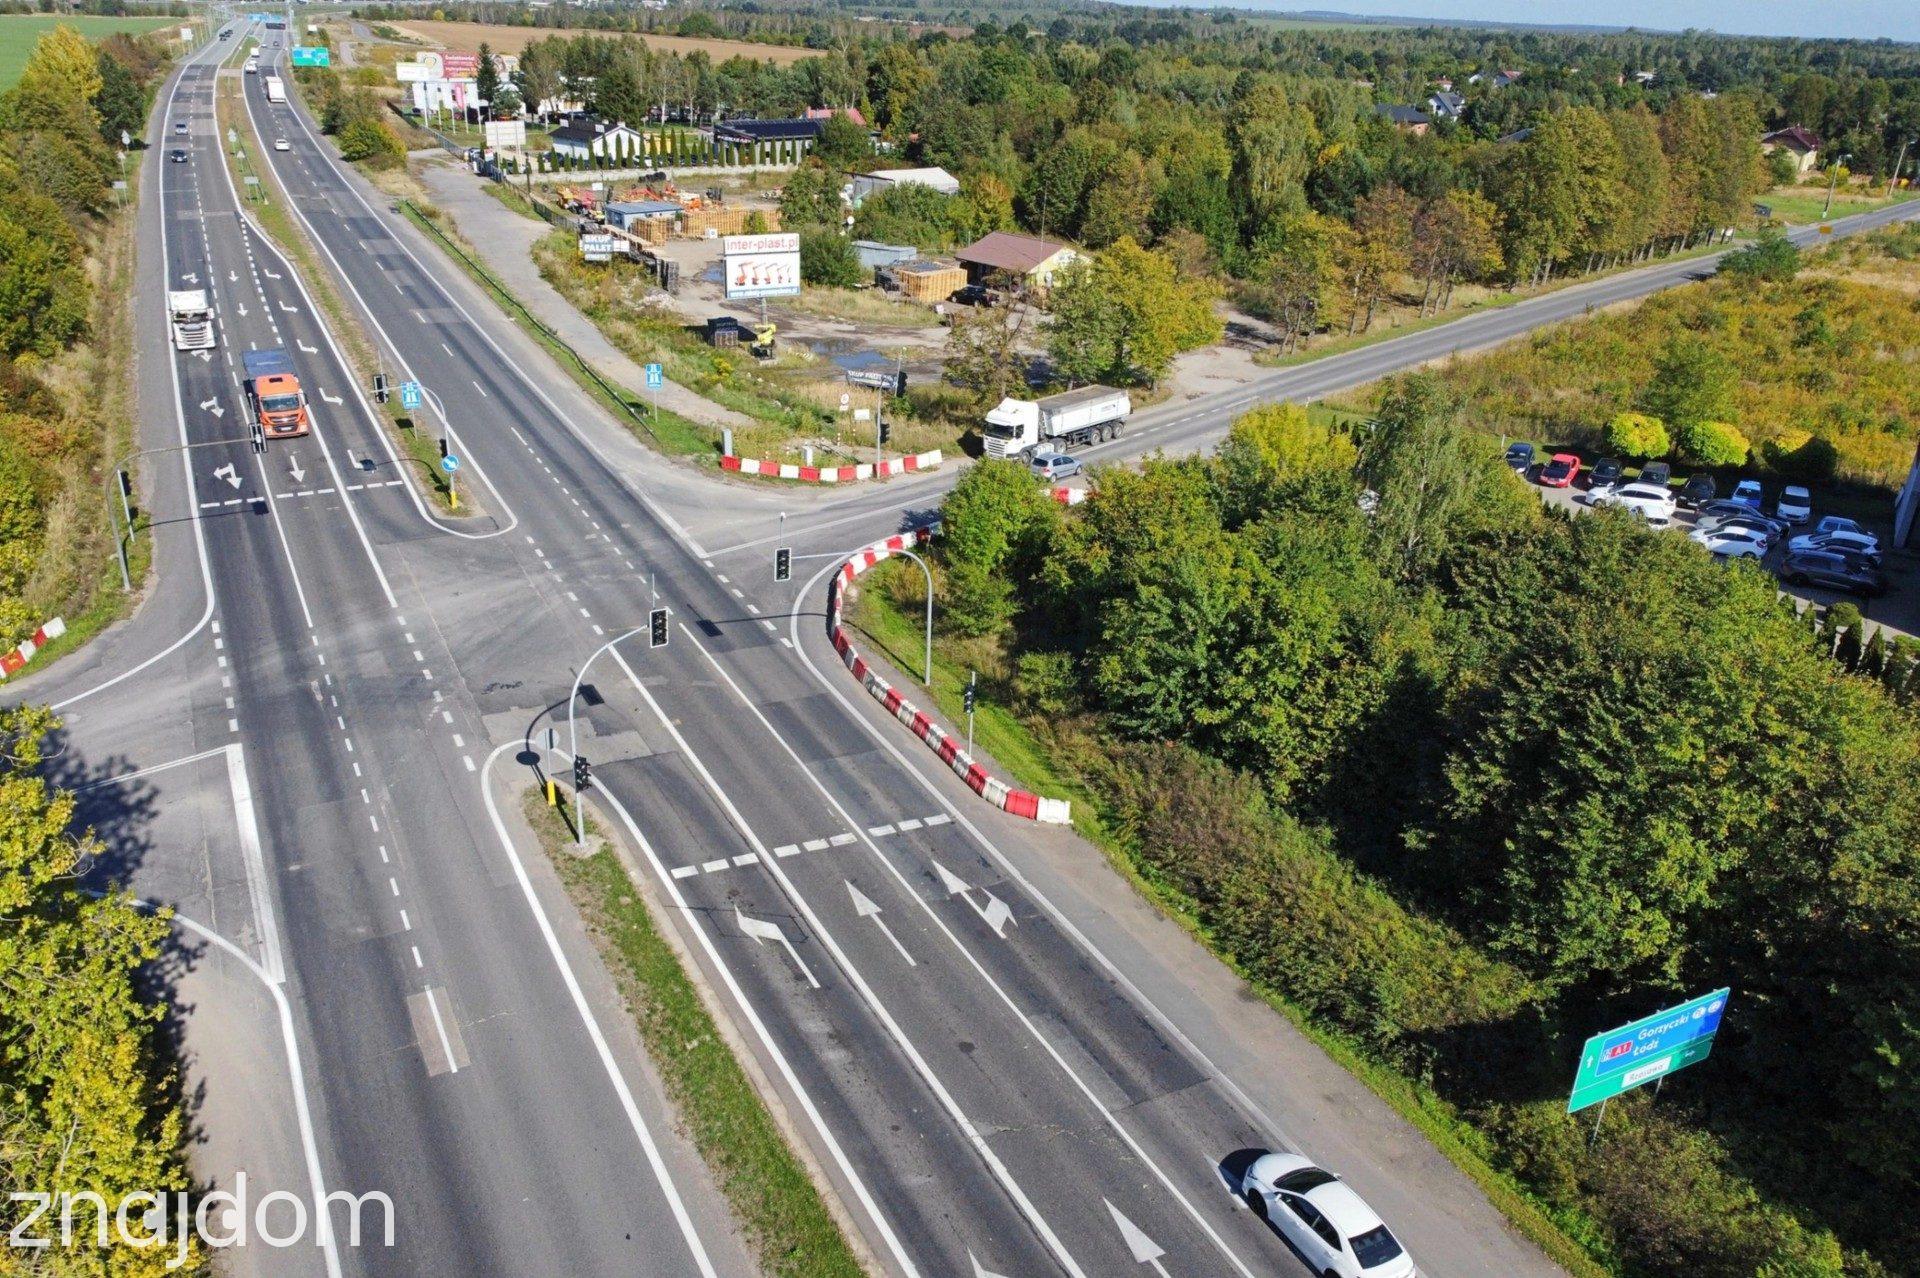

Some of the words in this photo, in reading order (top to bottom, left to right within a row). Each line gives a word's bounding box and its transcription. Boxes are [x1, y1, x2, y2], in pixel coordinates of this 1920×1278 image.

[584, 244, 612, 252] PALET
[727, 237, 798, 251] inter-plast.pl
[1638, 1012, 1690, 1040] Gorzyczki
